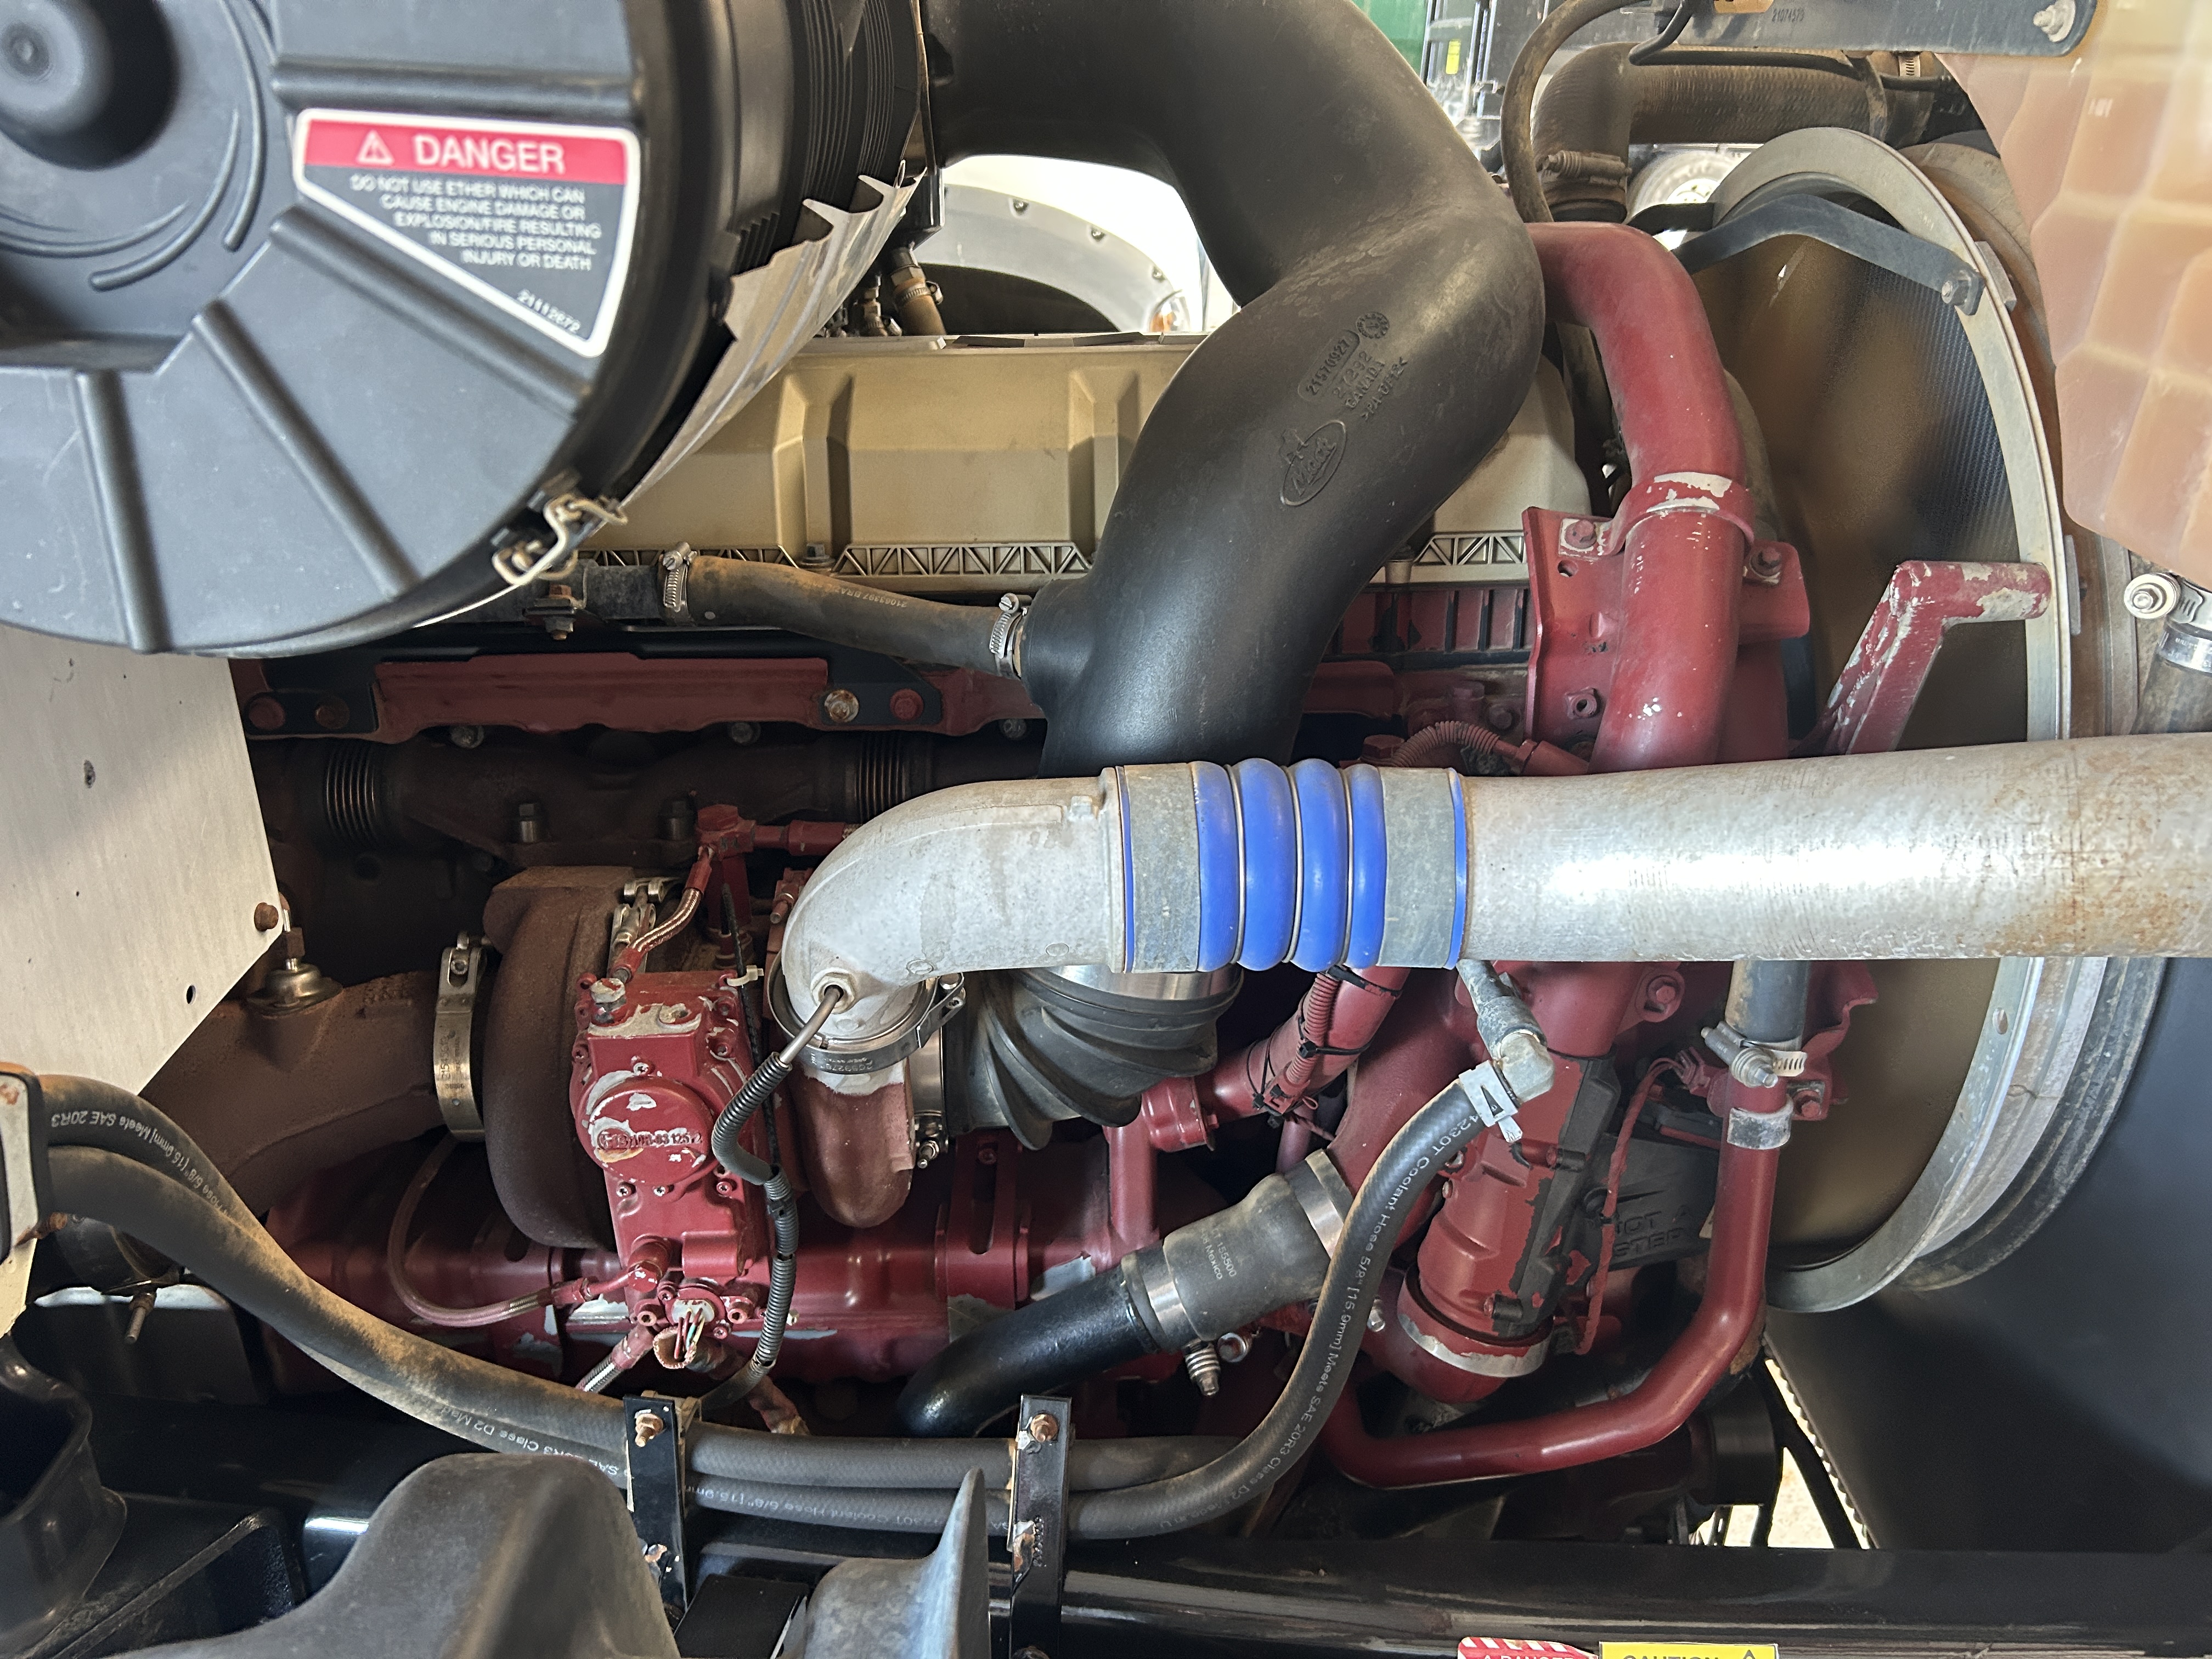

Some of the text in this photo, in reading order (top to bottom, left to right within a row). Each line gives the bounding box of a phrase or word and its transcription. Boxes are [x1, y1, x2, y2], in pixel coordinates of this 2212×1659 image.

[413, 134, 565, 174] DANGER
[349, 174, 585, 204] DO NOT USE ETHER WHICH CAN
[380, 193, 585, 221] CAUSE ENGINE DAMAGE OR
[428, 230, 597, 255] IN SERIOUS PERSONAL
[519, 219, 602, 239] RESULTING
[461, 247, 592, 271] INJURY OR DEATH
[1344, 360, 1386, 410] CANADA
[50, 1110, 88, 1127] 20R3
[91, 1110, 116, 1127] SAE
[119, 1115, 151, 1139] Meets
[1385, 1155, 1430, 1211] Coolant
[1364, 1213, 1392, 1253] Hose
[1614, 1227, 1684, 1257] STEP
[1204, 1244, 1224, 1280] Mexico
[1216, 1242, 1237, 1278] 155500
[1314, 1352, 1341, 1395] Meets
[1301, 1395, 1323, 1424] SAE
[473, 1420, 495, 1436] D2
[499, 1430, 539, 1452] Class
[1279, 1424, 1307, 1457] 20R3
[1249, 1456, 1281, 1485] Class
[1231, 1484, 1250, 1500] D2
[784, 1502, 825, 1516] Hose
[830, 1508, 889, 1524] Coolant
